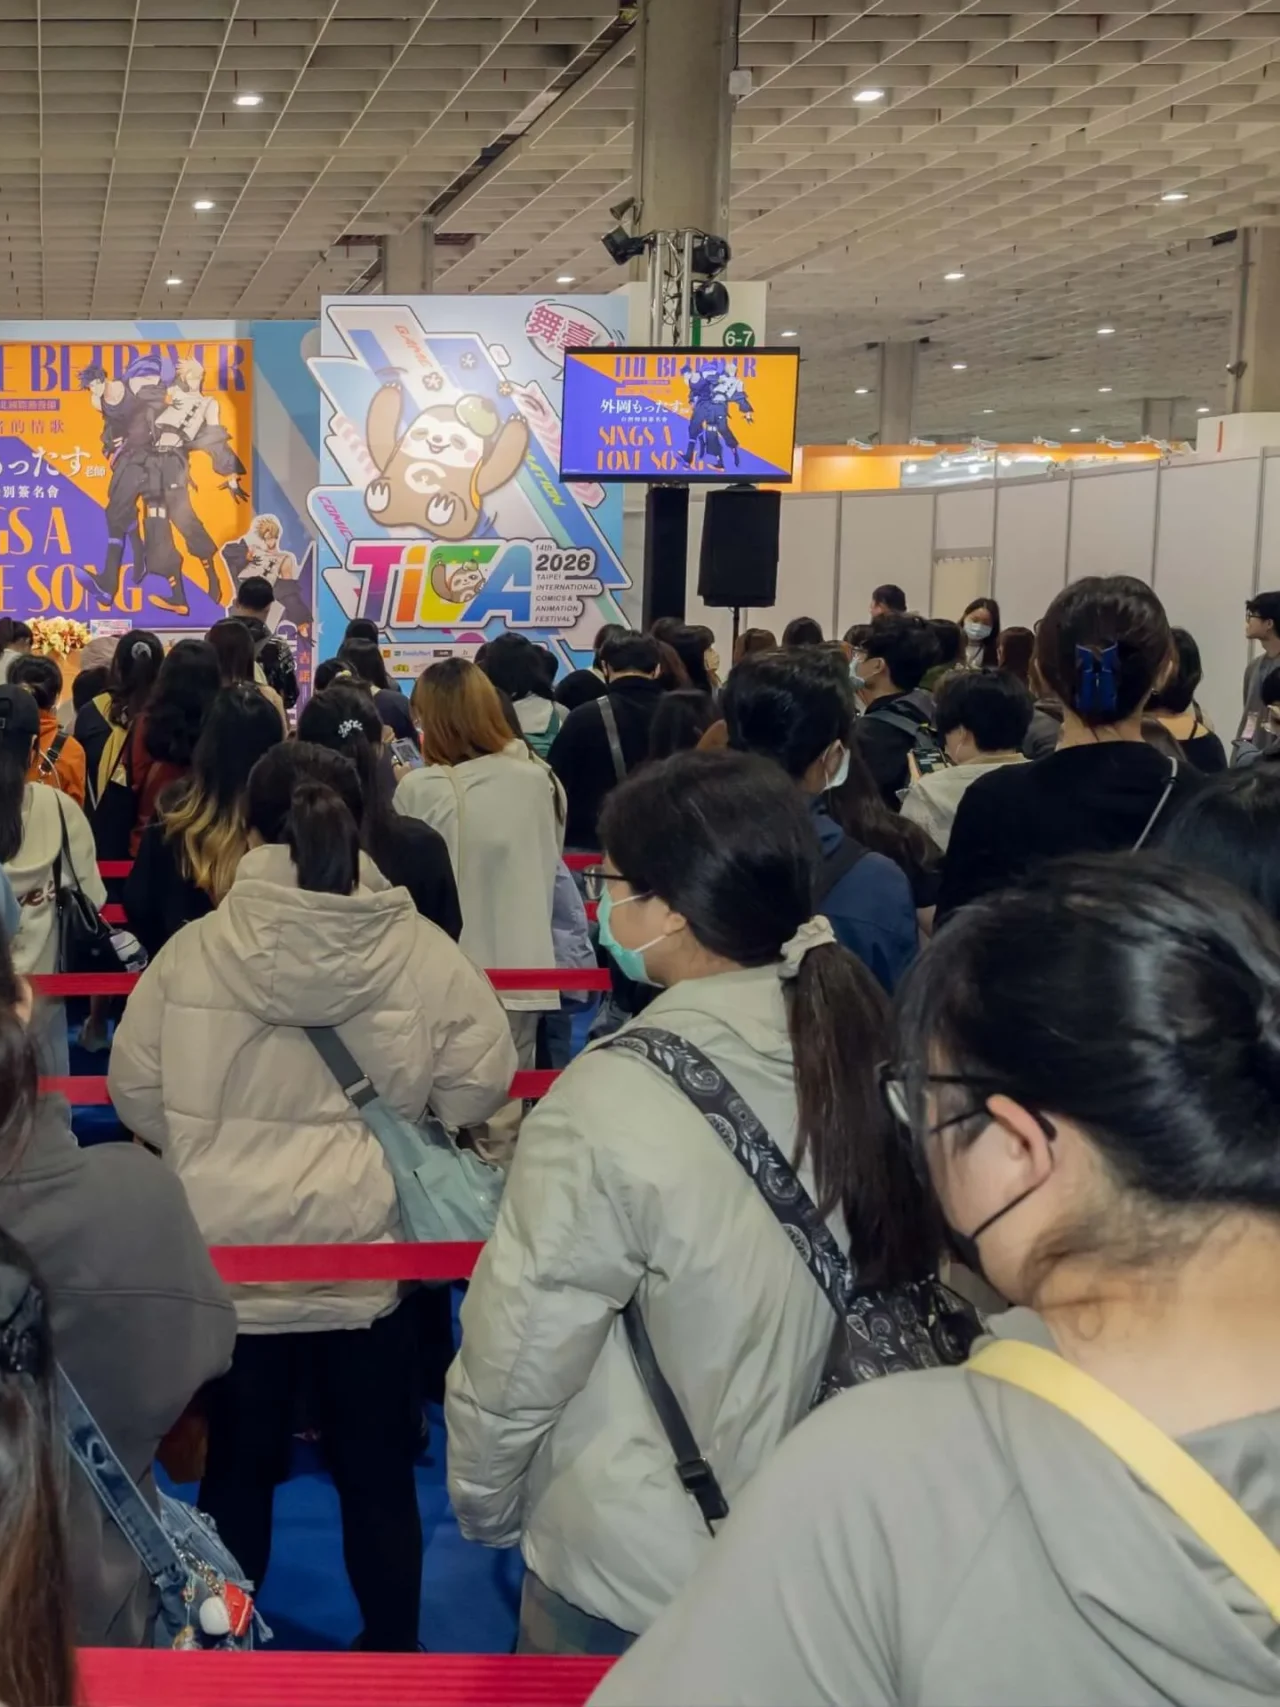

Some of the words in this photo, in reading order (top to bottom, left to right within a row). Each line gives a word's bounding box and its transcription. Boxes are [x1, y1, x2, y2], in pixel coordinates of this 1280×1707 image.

[725, 331, 753, 347] 6-7
[598, 425, 655, 446] SINGS
[44, 507, 72, 555] A
[535, 553, 591, 571] 2026
